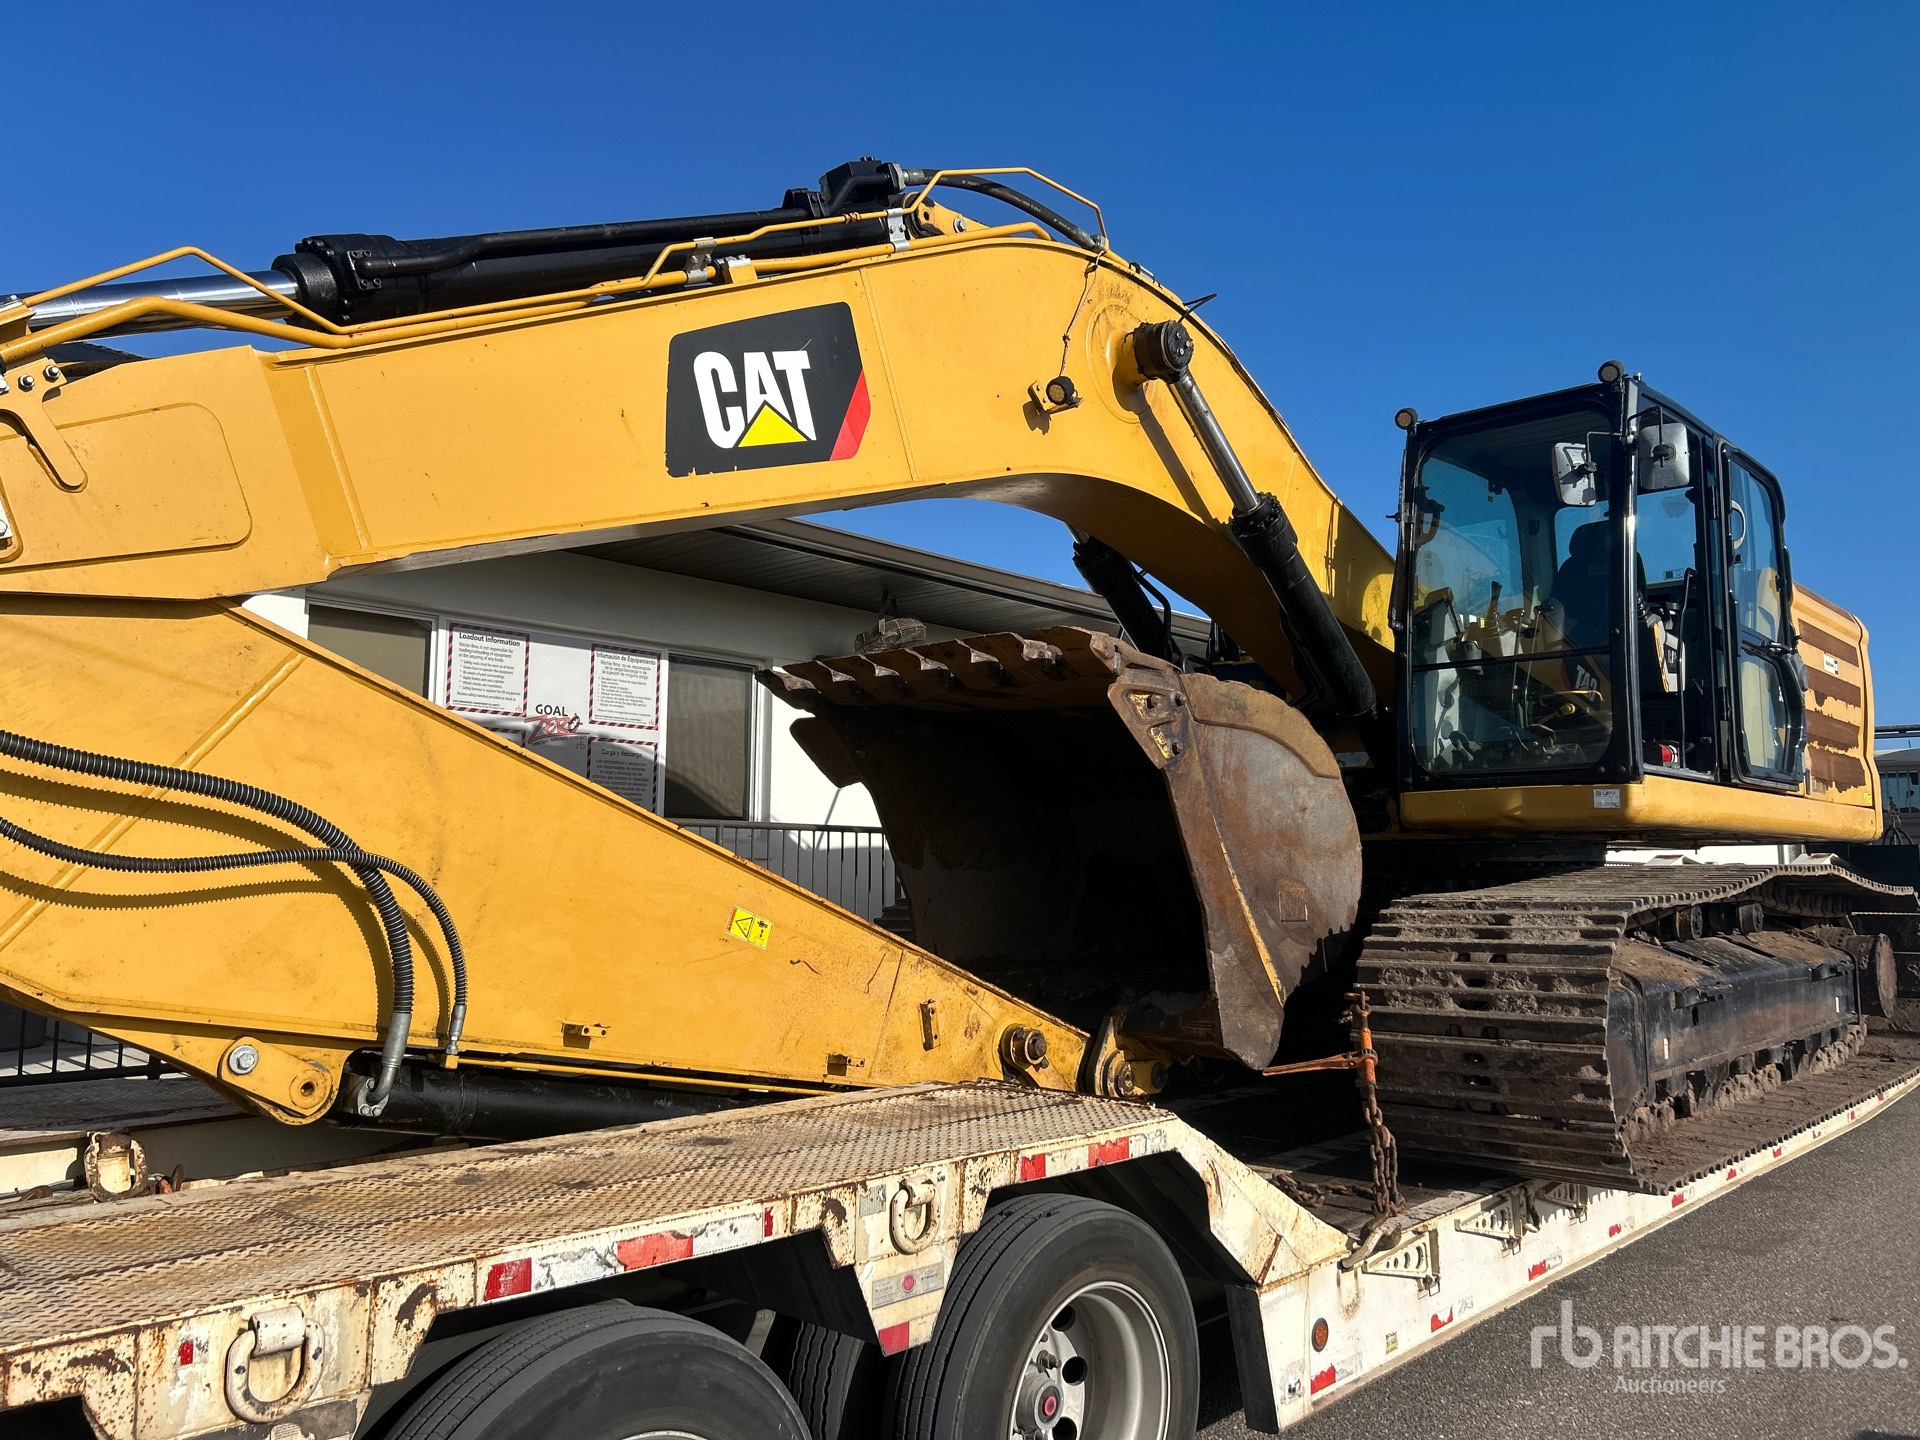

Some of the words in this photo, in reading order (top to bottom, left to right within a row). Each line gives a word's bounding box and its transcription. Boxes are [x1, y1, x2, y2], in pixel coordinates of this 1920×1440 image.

[693, 350, 817, 449] CAT
[459, 632, 484, 641] Loadout
[485, 635, 520, 646] Information
[627, 655, 655, 666] Equipamiento
[535, 704, 568, 717] GOAL
[524, 713, 584, 744] ZERO
[601, 748, 615, 756] Carga
[620, 750, 642, 758] descarga
